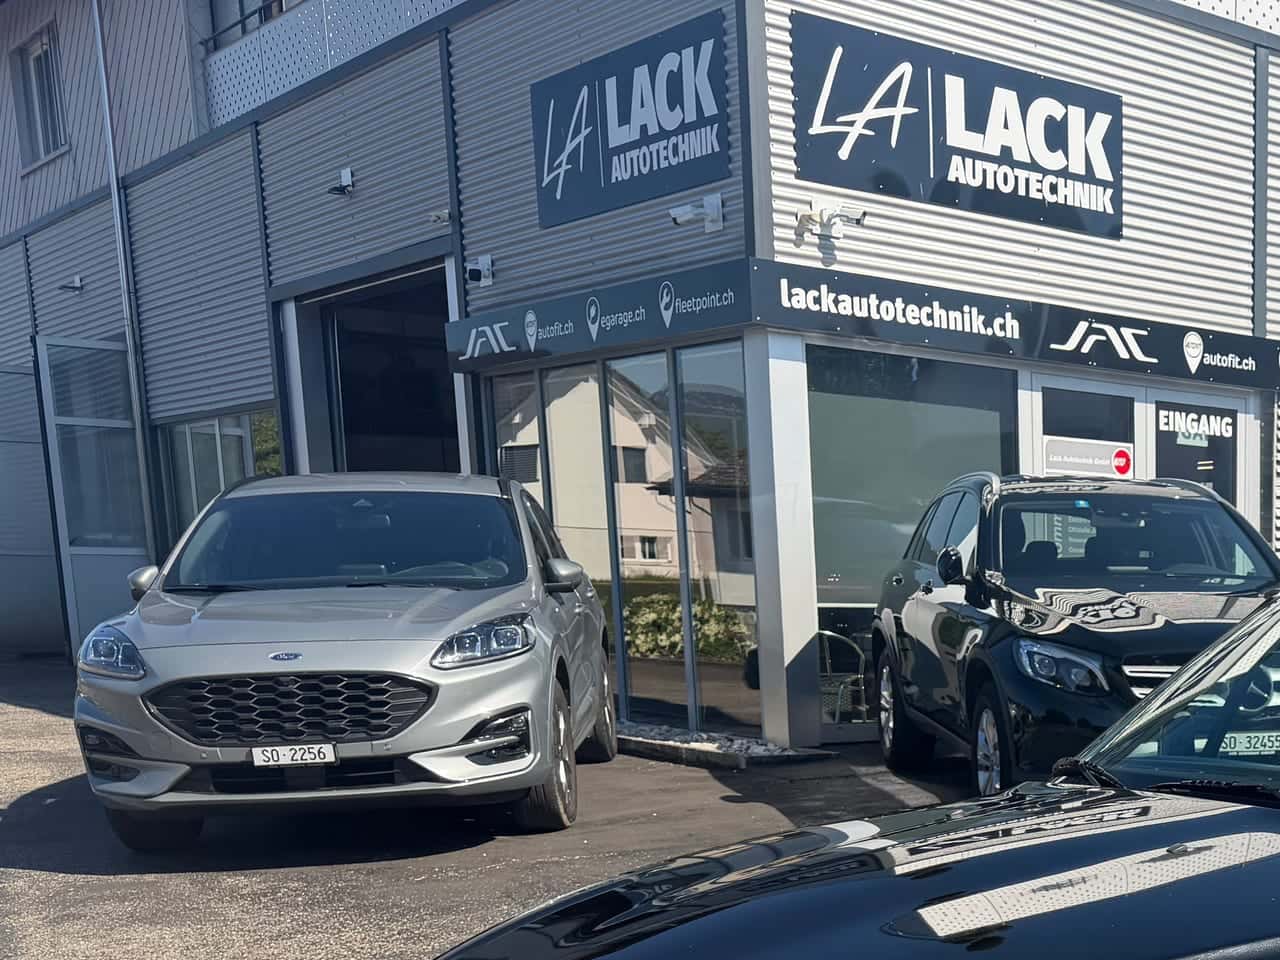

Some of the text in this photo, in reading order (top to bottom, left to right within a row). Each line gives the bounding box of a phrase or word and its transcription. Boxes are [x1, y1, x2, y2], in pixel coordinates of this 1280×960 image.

[605, 38, 719, 145] LACK
[945, 73, 1114, 183] LACK
[610, 123, 721, 184] AUTOTECHNIK
[947, 153, 1114, 215] AUTOTECHNIK
[600, 305, 646, 329] egarage.ch
[675, 289, 735, 314] fleetpoint.ch
[780, 278, 1020, 340] lackautotechnik.ch
[537, 319, 574, 340] autofit.ch
[1203, 353, 1256, 371] autofit.ch
[1159, 409, 1233, 438] EINGANG
